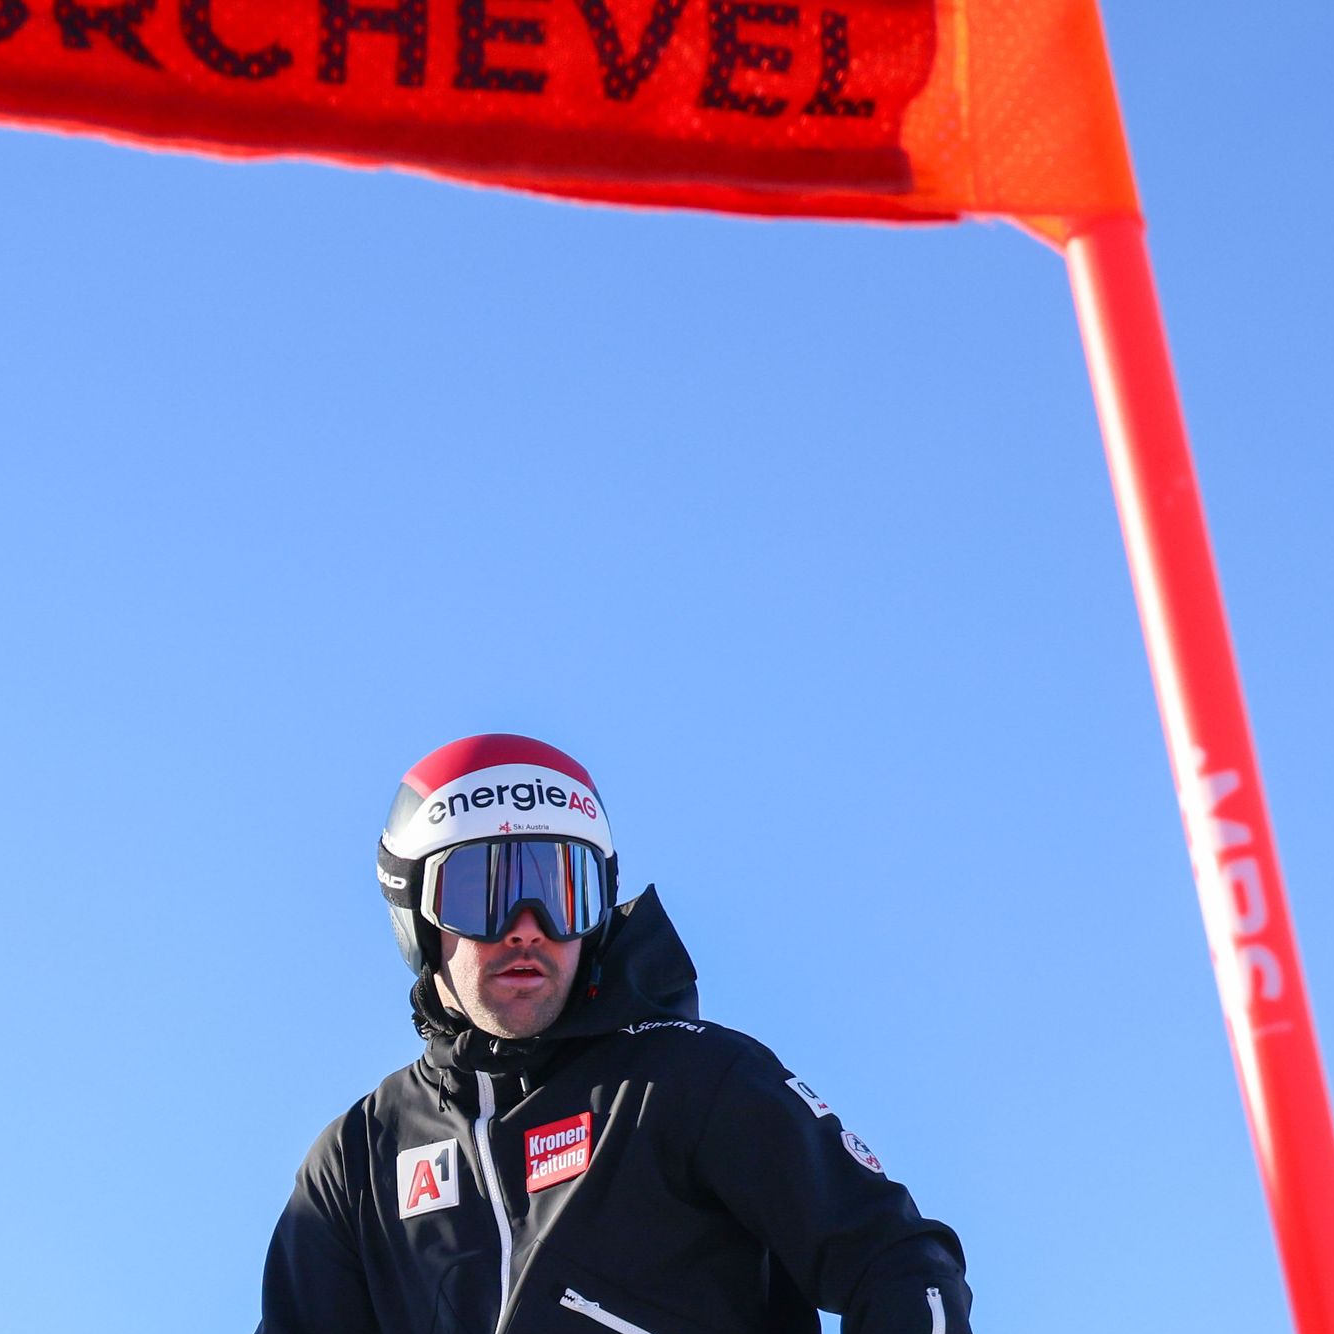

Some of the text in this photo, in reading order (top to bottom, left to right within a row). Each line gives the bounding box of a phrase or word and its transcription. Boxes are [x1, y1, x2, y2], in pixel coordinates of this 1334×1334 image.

[526, 823, 549, 831] Austria
[376, 862, 407, 890] EAD
[529, 1124, 586, 1157] Kronen
[406, 1147, 450, 1209] A1
[530, 1147, 585, 1180] Zeitung
